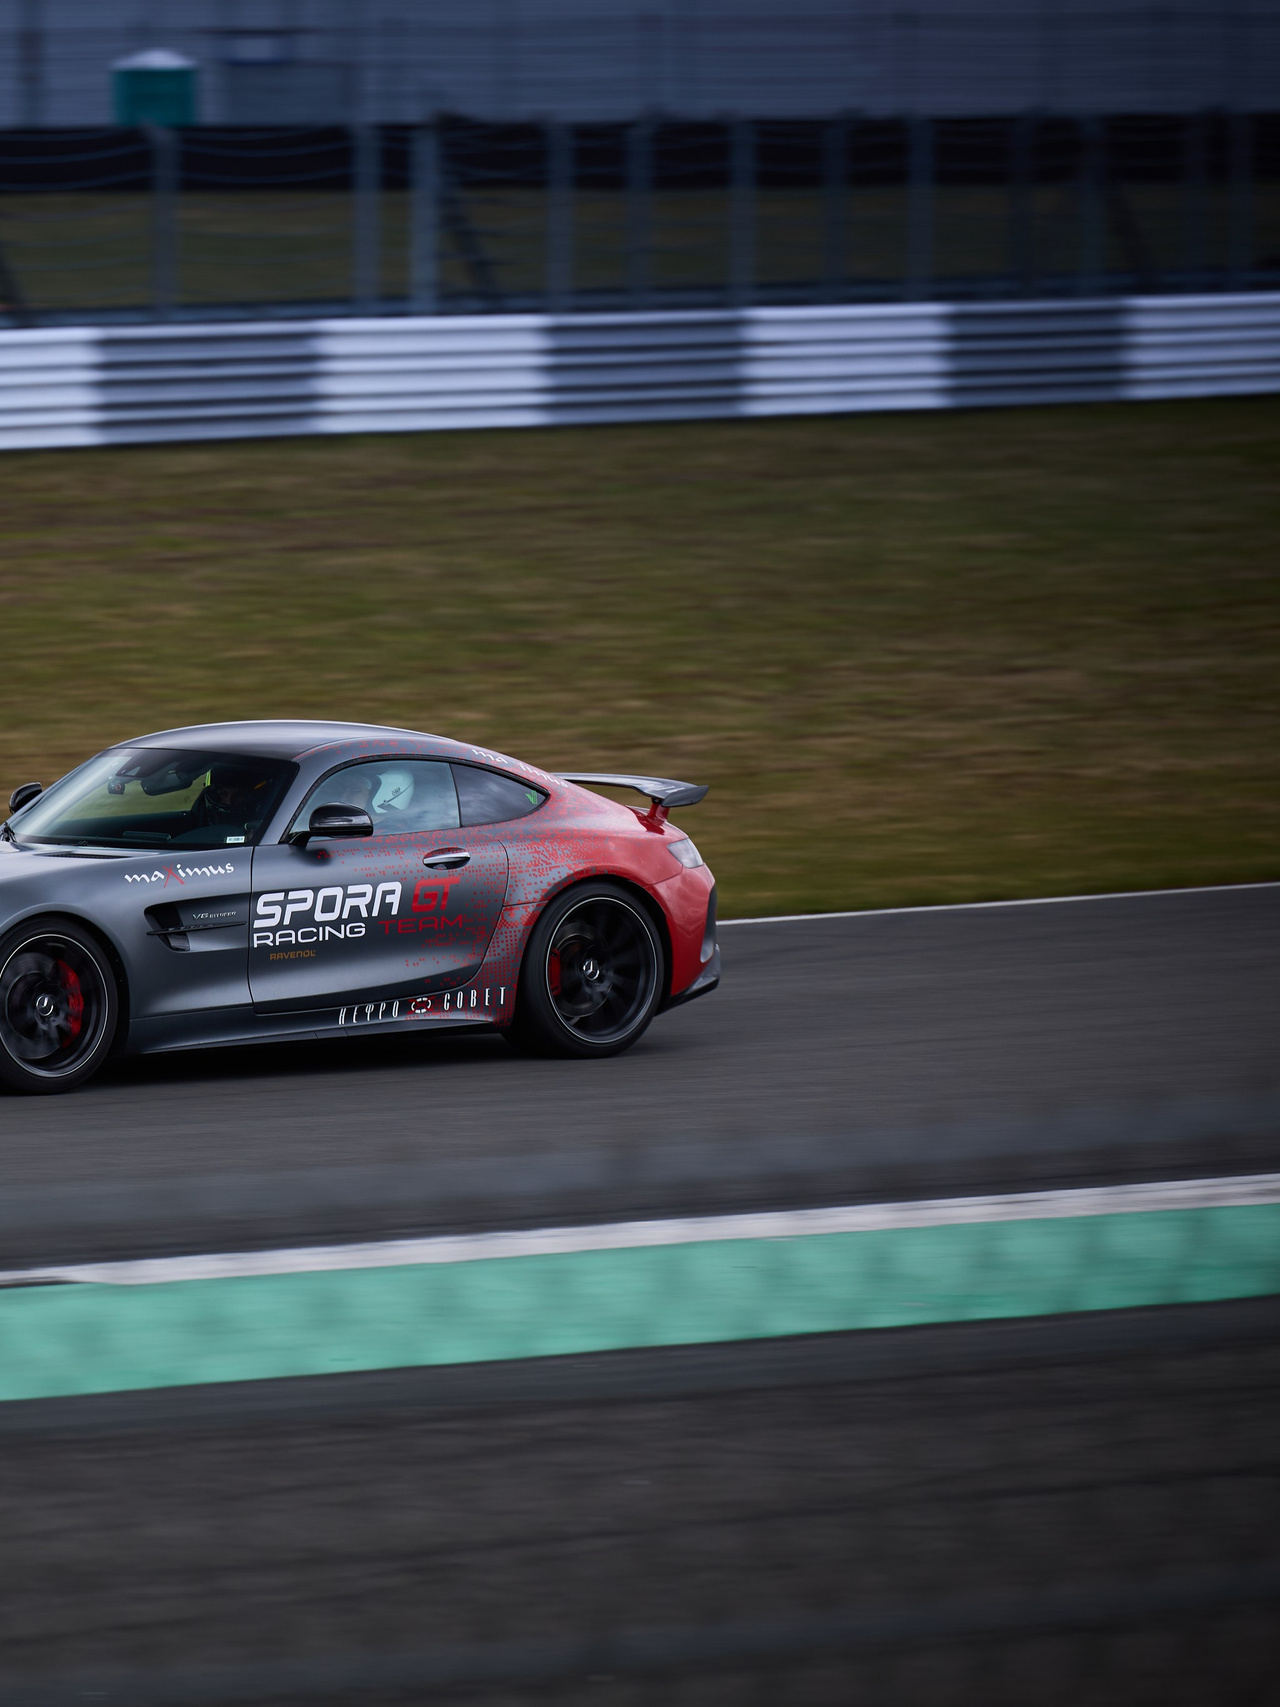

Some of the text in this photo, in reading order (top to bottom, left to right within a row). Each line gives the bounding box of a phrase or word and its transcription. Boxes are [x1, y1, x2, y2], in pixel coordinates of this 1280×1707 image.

[253, 876, 461, 929] SPORA GT
[253, 914, 463, 948] RACING TEAM
[269, 950, 316, 961] RAVENOL
